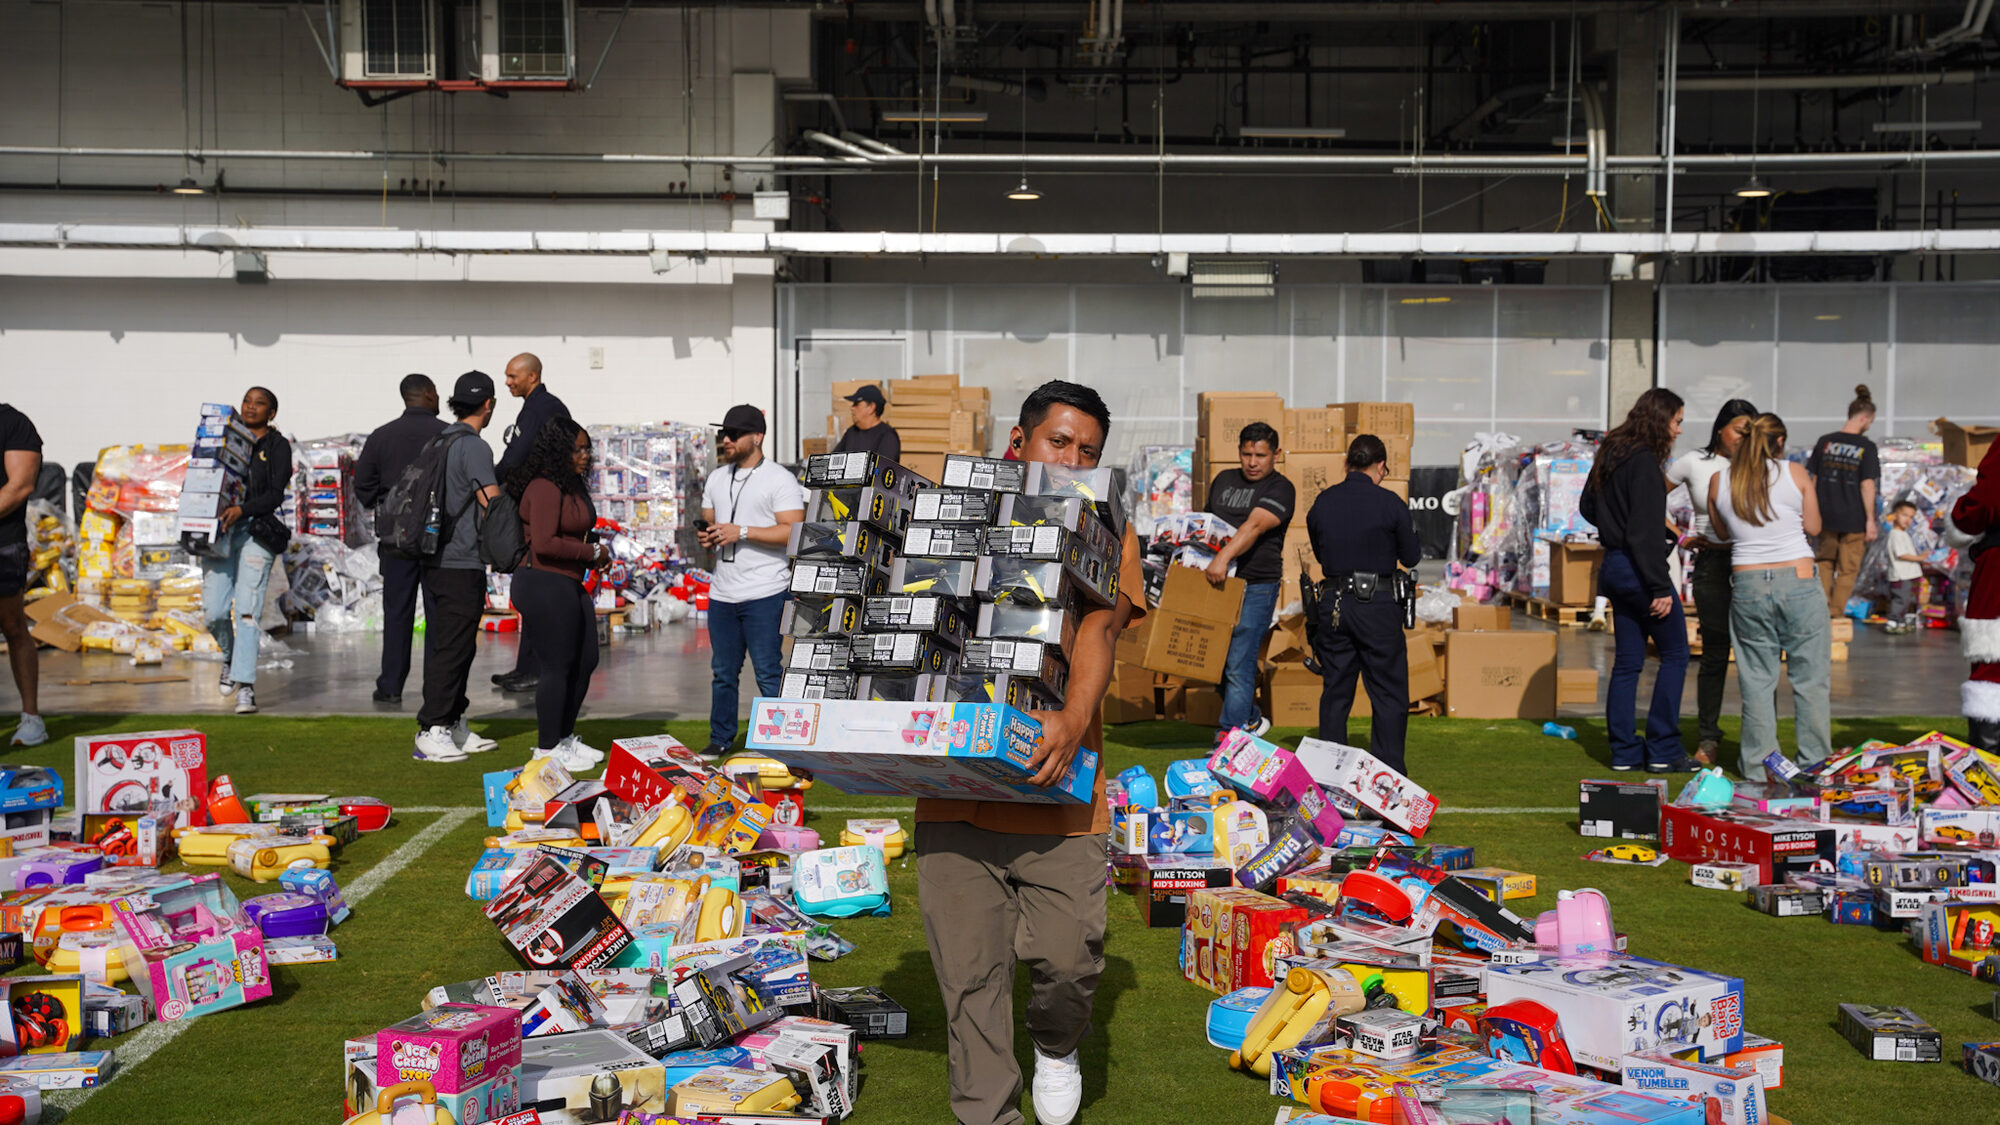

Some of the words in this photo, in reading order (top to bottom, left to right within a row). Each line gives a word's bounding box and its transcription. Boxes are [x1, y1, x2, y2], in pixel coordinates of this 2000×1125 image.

[1825, 442, 1864, 459] KITH
[980, 713, 988, 737] Paws
[986, 712, 996, 739] Happy
[1010, 716, 1034, 742] Happy
[1010, 733, 1031, 757] Paws
[177, 743, 188, 768] Band
[1410, 800, 1423, 826] Band
[1416, 803, 1432, 828] Kid's
[1255, 838, 1302, 884] GALAXY
[1949, 888, 1996, 898] TRANSFORMER
[604, 927, 624, 946] KID'S
[604, 935, 629, 956] MIKE
[1464, 924, 1508, 948] TUMBLER
[573, 943, 604, 969] BOXING
[587, 951, 608, 970] TYSO
[231, 960, 243, 983] STOP
[239, 950, 255, 986] CREAM
[252, 957, 262, 977] ICE
[514, 1017, 521, 1027] 3+
[1717, 1000, 1730, 1038] Band
[1728, 995, 1739, 1037] Kid's
[468, 1039, 482, 1051] ICE
[500, 1041, 511, 1050] Your
[1361, 1034, 1384, 1046] WARS
[1392, 1037, 1413, 1048] WARS
[1393, 1031, 1413, 1041] STAR
[405, 1043, 427, 1057] ICE
[462, 1045, 488, 1067] CREAM
[496, 1048, 509, 1059] Cream
[1360, 1041, 1384, 1052] STAR
[394, 1055, 439, 1071] CREAM
[466, 1062, 483, 1078] STOP
[400, 1069, 431, 1080] STOP
[1627, 1068, 1665, 1078] VENOM
[1637, 1078, 1688, 1089] TUMBLER
[834, 1085, 843, 1114] WARS
[1748, 1084, 1758, 1124] VENOM
[466, 1104, 476, 1117] 27
